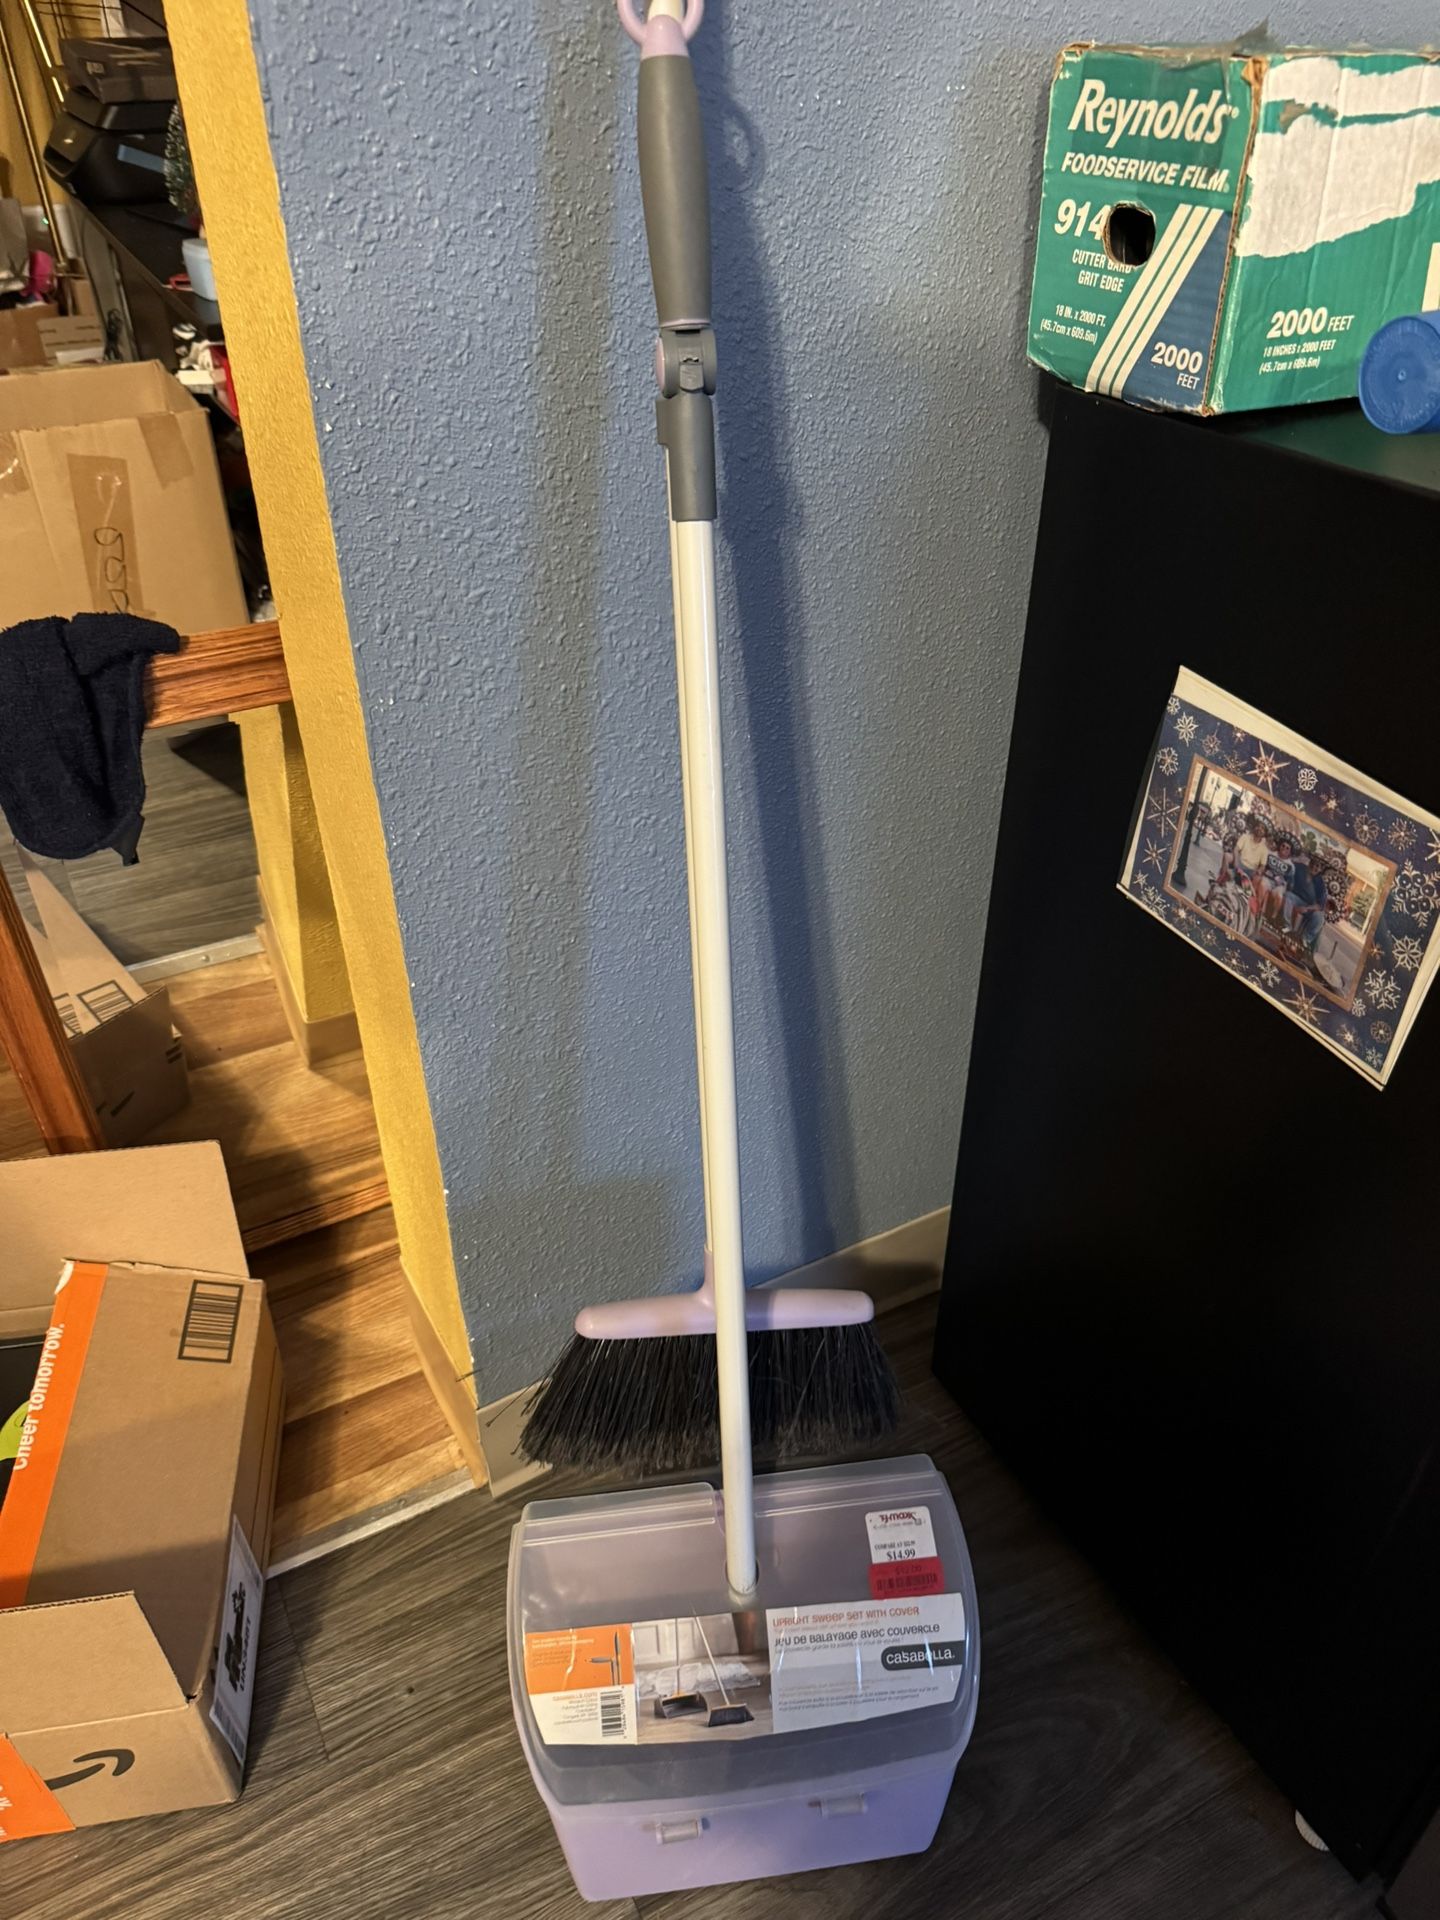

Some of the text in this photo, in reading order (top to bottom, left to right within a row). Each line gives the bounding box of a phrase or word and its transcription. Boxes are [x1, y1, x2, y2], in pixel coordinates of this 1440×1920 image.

[1067, 79, 1232, 149] Reynolds
[1061, 152, 1229, 192] FOODSERVICE FILM
[1054, 198, 1110, 241] 914
[1072, 248, 1107, 269] CUTTER
[1078, 269, 1125, 293] GRIT EDGE
[1056, 304, 1107, 327] 18 IN. x 2000 FT.
[1266, 306, 1355, 339] 2000 FEET
[1040, 318, 1099, 346] (45.7cm x 609.6m)
[1151, 341, 1204, 374] 2000
[1263, 346, 1273, 358] 18
[1272, 343, 1297, 357] INCHES
[1300, 341, 1320, 354] 2000
[1319, 339, 1337, 352] FEET
[1259, 360, 1287, 376] (45.7cm
[1287, 361, 1293, 370] x
[1176, 372, 1201, 391] FEET
[28, 1323, 66, 1414] tomorrow.
[886, 1548, 916, 1561] $14.99
[866, 1608, 887, 1619] WITH
